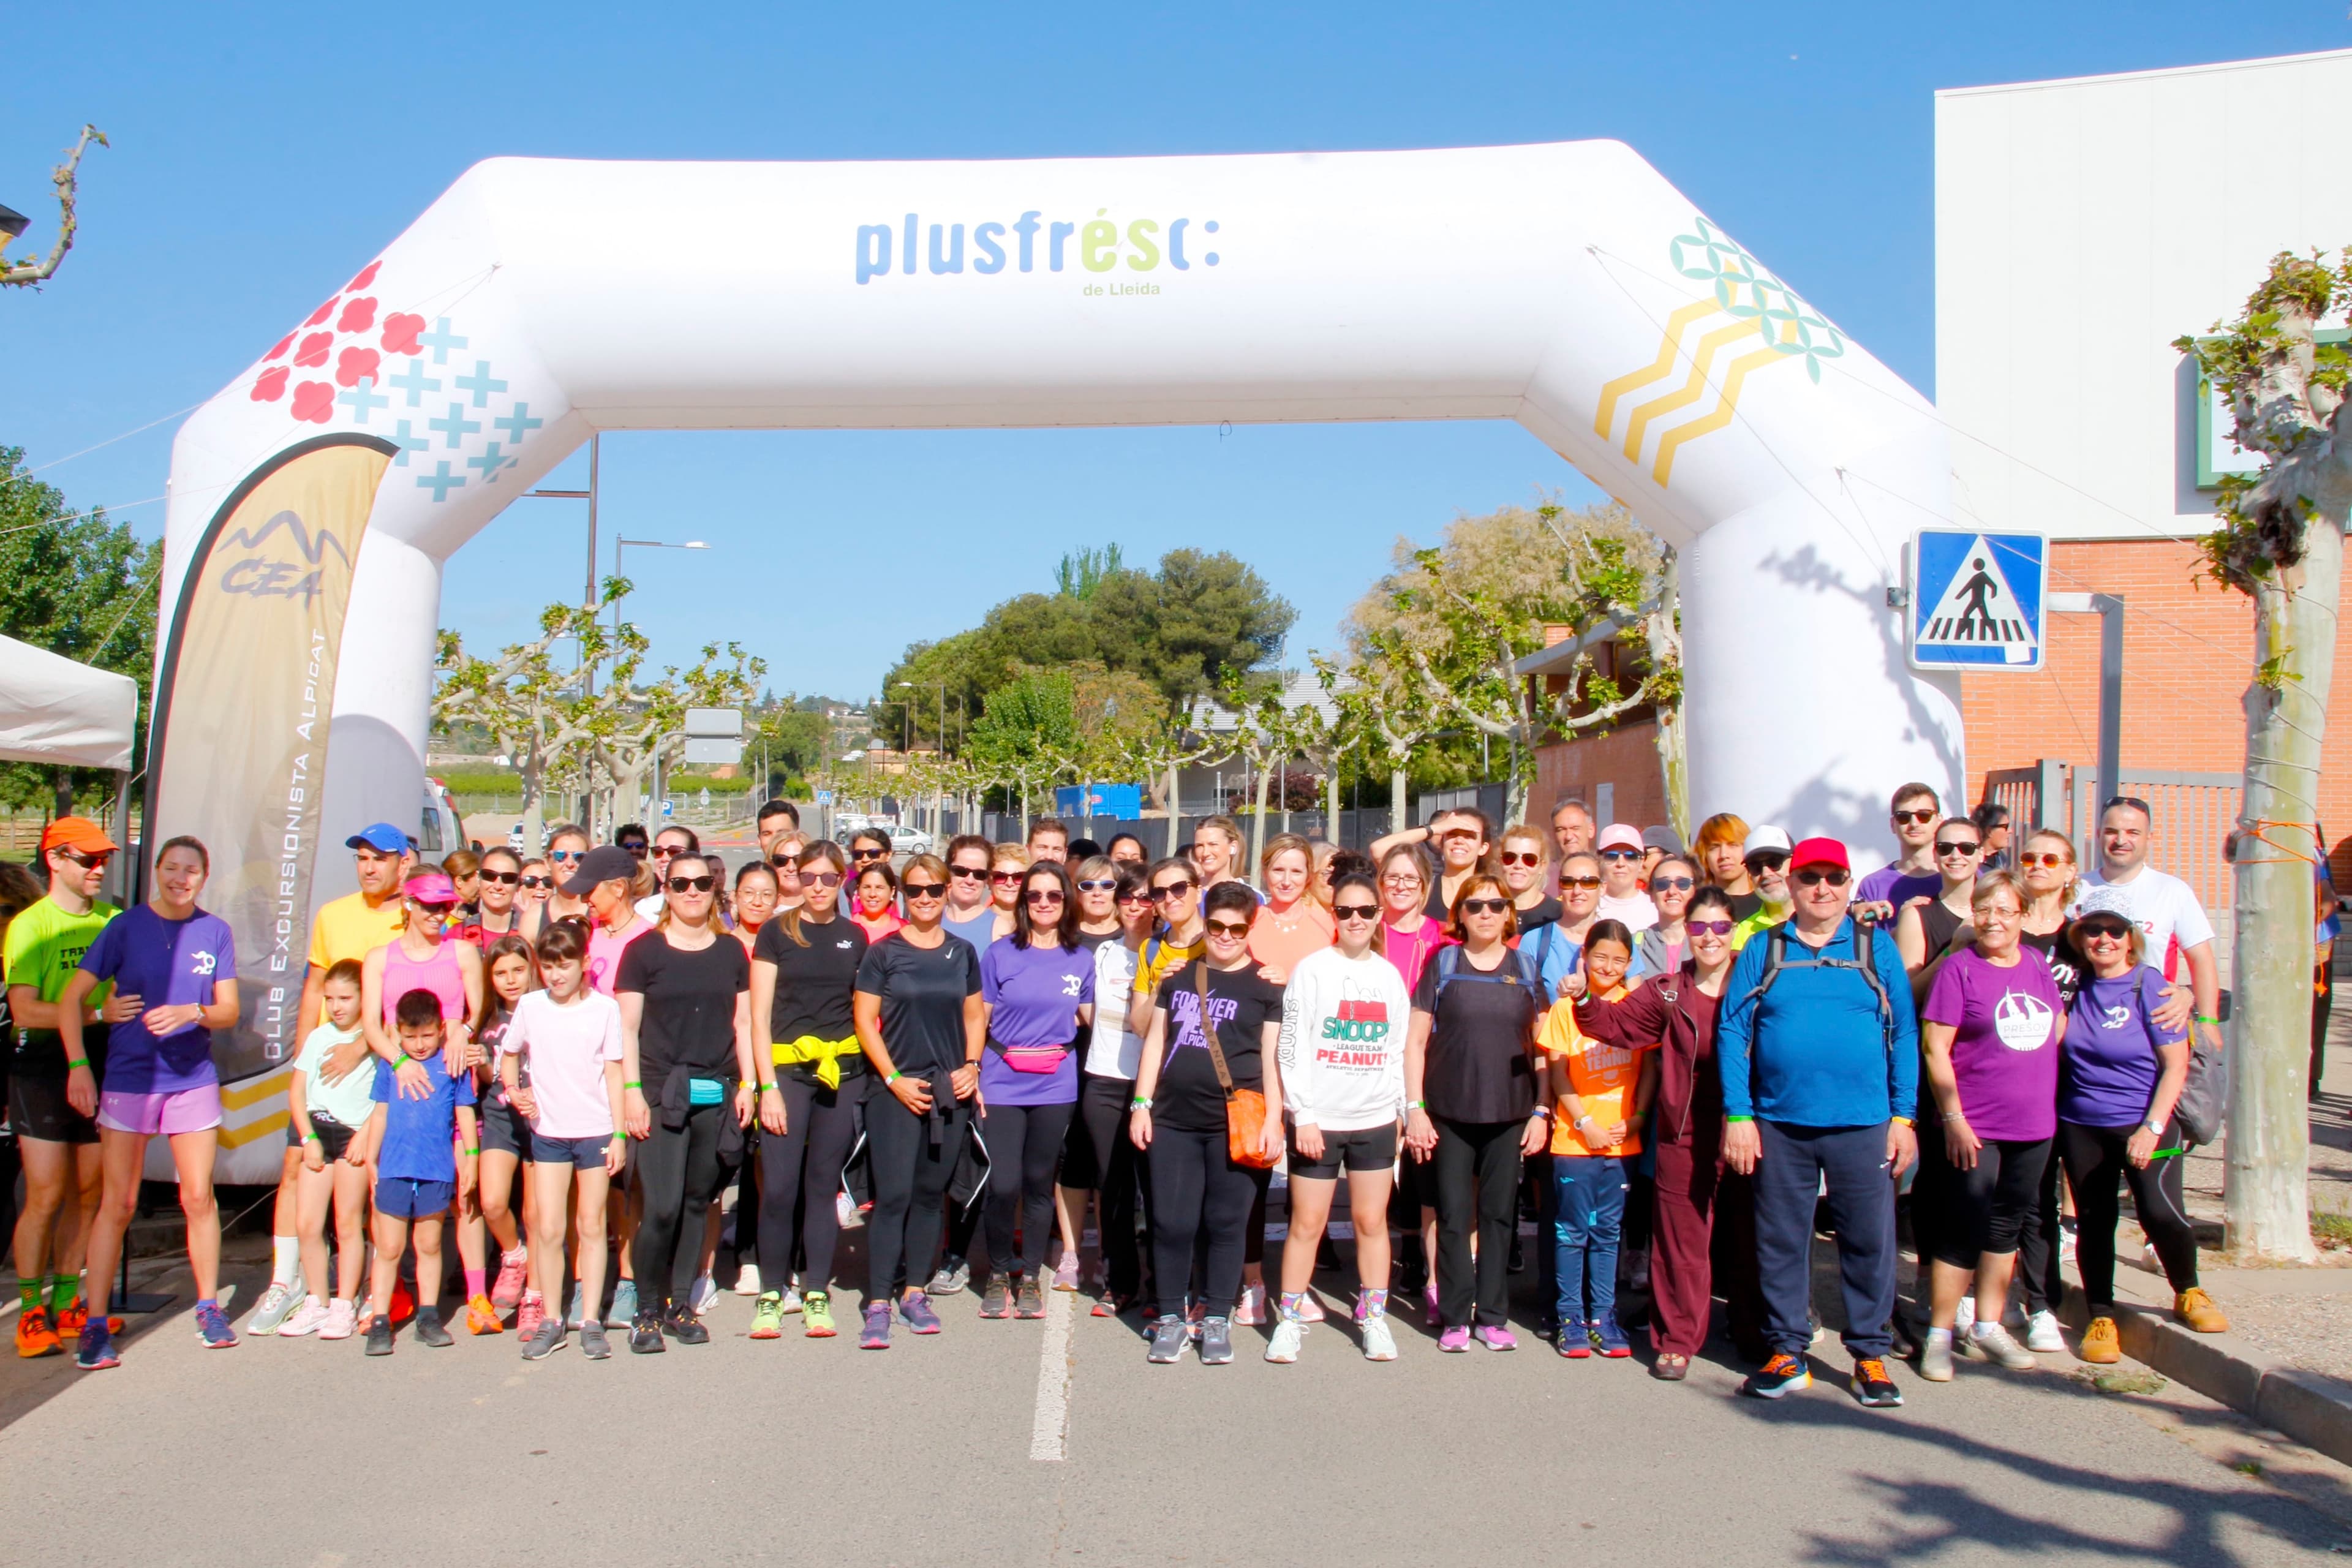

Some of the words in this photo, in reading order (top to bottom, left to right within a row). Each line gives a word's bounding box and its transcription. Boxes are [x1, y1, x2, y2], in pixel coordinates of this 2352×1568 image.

[1083, 283, 1102, 296] de
[1110, 283, 1160, 296] Lleida
[221, 554, 326, 612] CEA
[296, 628, 325, 741] ALPICAT
[270, 752, 309, 972] EXCURSIONISTA
[60, 945, 89, 958] TRA
[264, 986, 285, 1060] CLUB
[1321, 1016, 1389, 1042] SNOOP
[1181, 1034, 1210, 1049] ALPICA
[1336, 1043, 1364, 1052] LEAGUE
[1586, 1049, 1632, 1072] TENNIS
